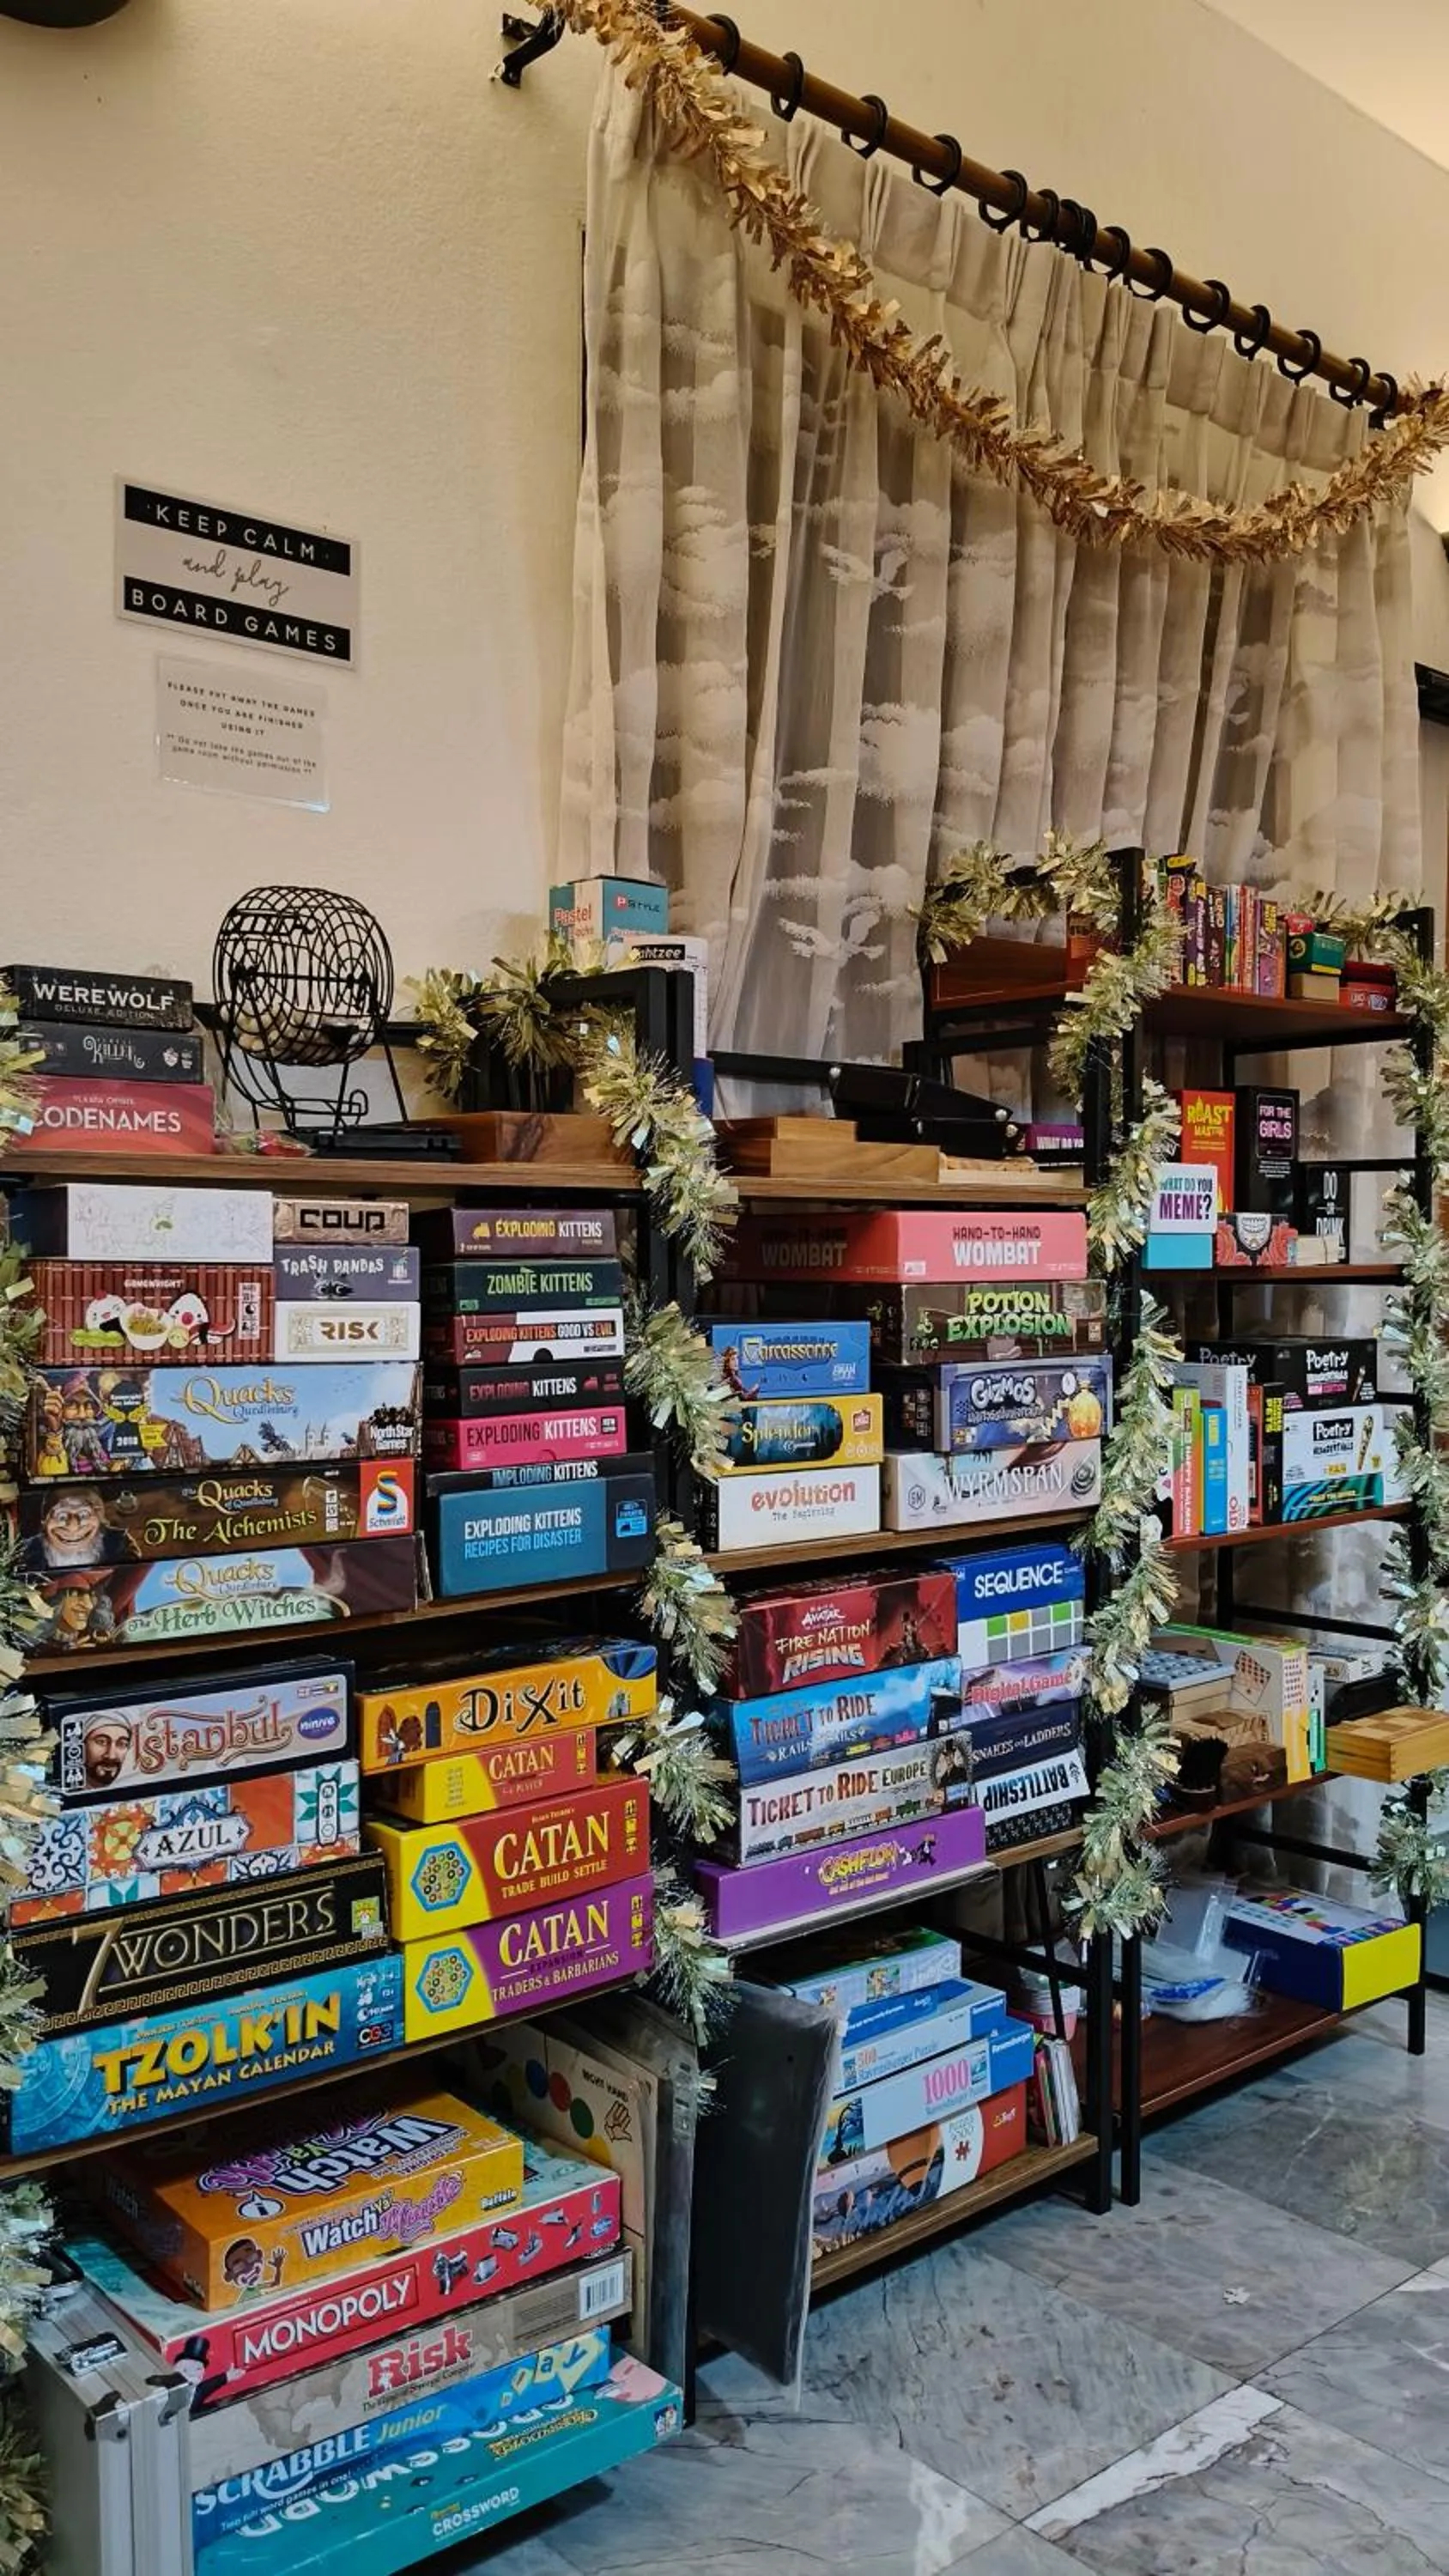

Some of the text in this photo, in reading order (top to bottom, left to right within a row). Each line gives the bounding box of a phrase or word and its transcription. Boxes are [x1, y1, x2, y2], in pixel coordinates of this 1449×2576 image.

[156, 504, 313, 560] KEEP CALM
[183, 549, 289, 606] and play
[132, 588, 336, 650] BOARD GAMES
[634, 947, 682, 959] ahtzee
[33, 983, 174, 1011] WEREWOLF
[55, 1004, 103, 1016] DELUXE
[1187, 1103, 1233, 1125] ROAST
[1260, 1106, 1291, 1118] FOR THE
[1259, 1120, 1291, 1139] GIRLS
[1160, 1178, 1212, 1193] WHAT DO YOU
[1324, 1172, 1337, 1200] DO
[300, 1209, 385, 1232] COUP
[1160, 1194, 1212, 1219] MEME?
[495, 1219, 603, 1238] EXPLODING KITTENS
[953, 1226, 1041, 1239] HAND-TO-HAND
[281, 1255, 385, 1276] TRASH PANDAS
[761, 1242, 847, 1267] WOMBAT
[953, 1240, 1042, 1266] WOMBAT
[488, 1272, 593, 1295] ZOMBIE KITTENS
[967, 1291, 1051, 1314] POTION
[319, 1321, 379, 1340] RISK
[466, 1321, 614, 1344] EXPLODING KITTENS GOOD VS EVIL
[947, 1314, 1072, 1341] EXPLOSION
[1199, 1348, 1257, 1367] Poetry
[1307, 1349, 1349, 1370] Poetry
[171, 1375, 297, 1424] Quacks
[470, 1377, 577, 1402] EXPLODING KITTENS
[371, 1424, 414, 1439] North Star
[467, 1423, 540, 1447] EXPLODING
[544, 1416, 598, 1440] KITTENS
[742, 1419, 812, 1453] Splendor
[1317, 1423, 1351, 1439] Poetry
[493, 1461, 598, 1488] IMPLODING KITTENS
[946, 1463, 1064, 1502] WYRMSPAN
[192, 1479, 274, 1515] Quacks
[751, 1480, 856, 1511] evolution
[144, 1518, 197, 1546] The
[203, 1510, 317, 1545] Alchemists
[465, 1508, 582, 1540] EXPLODING KITTENS
[465, 1528, 582, 1559] RECIPES FOR DISASTER
[167, 1558, 276, 1601] Quacks
[974, 1561, 1064, 1598] SEQUENCE
[155, 1603, 217, 1631] Herb
[223, 1595, 317, 1625] Witches
[775, 1619, 870, 1654] FIRE NATION
[783, 1643, 865, 1684] RISING
[837, 1694, 877, 1721] RIDE
[131, 1696, 292, 1774] Istanbul
[778, 1740, 813, 1761] RAILS
[1024, 1722, 1071, 1747] LADDERS
[488, 1744, 554, 1780] CATAN
[747, 1760, 926, 1826] TICKET TO RIDE EUROPE
[983, 1764, 1069, 1812] BATTLESHIP
[155, 1824, 232, 1859] AZUL
[494, 1812, 609, 1880] CATAN
[501, 1860, 608, 1899] TRADE BUILD SETTLE
[499, 1900, 609, 1966] CATAN
[72, 1891, 336, 2016] 7 WONDERS
[493, 1977, 543, 2002] TRADERS
[554, 1951, 619, 1984] BARBARIANS
[93, 1991, 342, 2097] TZOLK'IN
[107, 2040, 336, 2117] THE MAYAN CALENDAR
[923, 2059, 970, 2105] 1000
[276, 2117, 451, 2193] Watch
[304, 2207, 379, 2257] Watch
[244, 2275, 410, 2364] MONOPOLY
[368, 2321, 471, 2398] Risk
[195, 2424, 372, 2516] SCRABBLE
[376, 2403, 447, 2443] Junior
[433, 2487, 520, 2537] CROSSWORD
